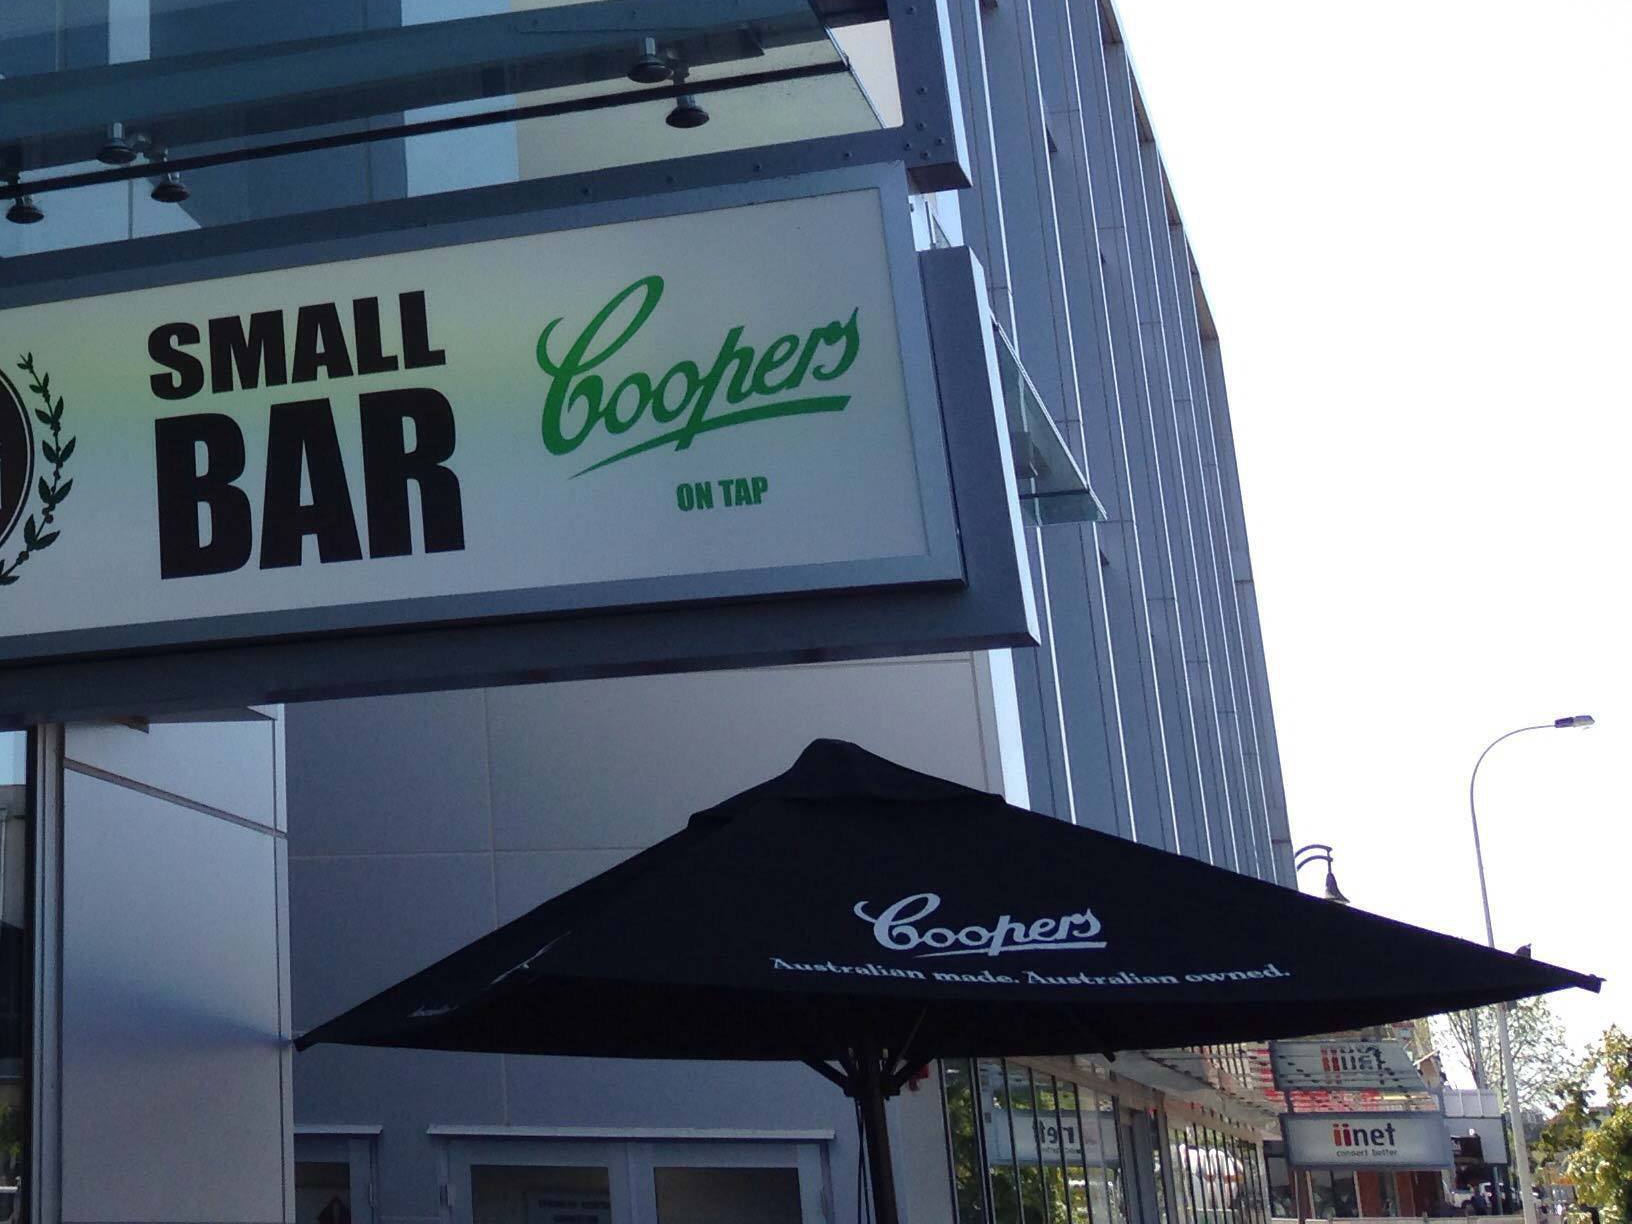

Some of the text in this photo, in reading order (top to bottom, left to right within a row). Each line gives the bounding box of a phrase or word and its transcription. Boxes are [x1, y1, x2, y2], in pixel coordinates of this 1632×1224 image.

[148, 290, 446, 400] SMALL
[536, 275, 860, 466] Coopers
[155, 388, 465, 580] BAR
[676, 477, 768, 512] ON TAP
[854, 893, 1103, 957] Coopers
[769, 958, 1290, 985] Australian made. Australian owned.
[1333, 1122, 1396, 1147] iinet
